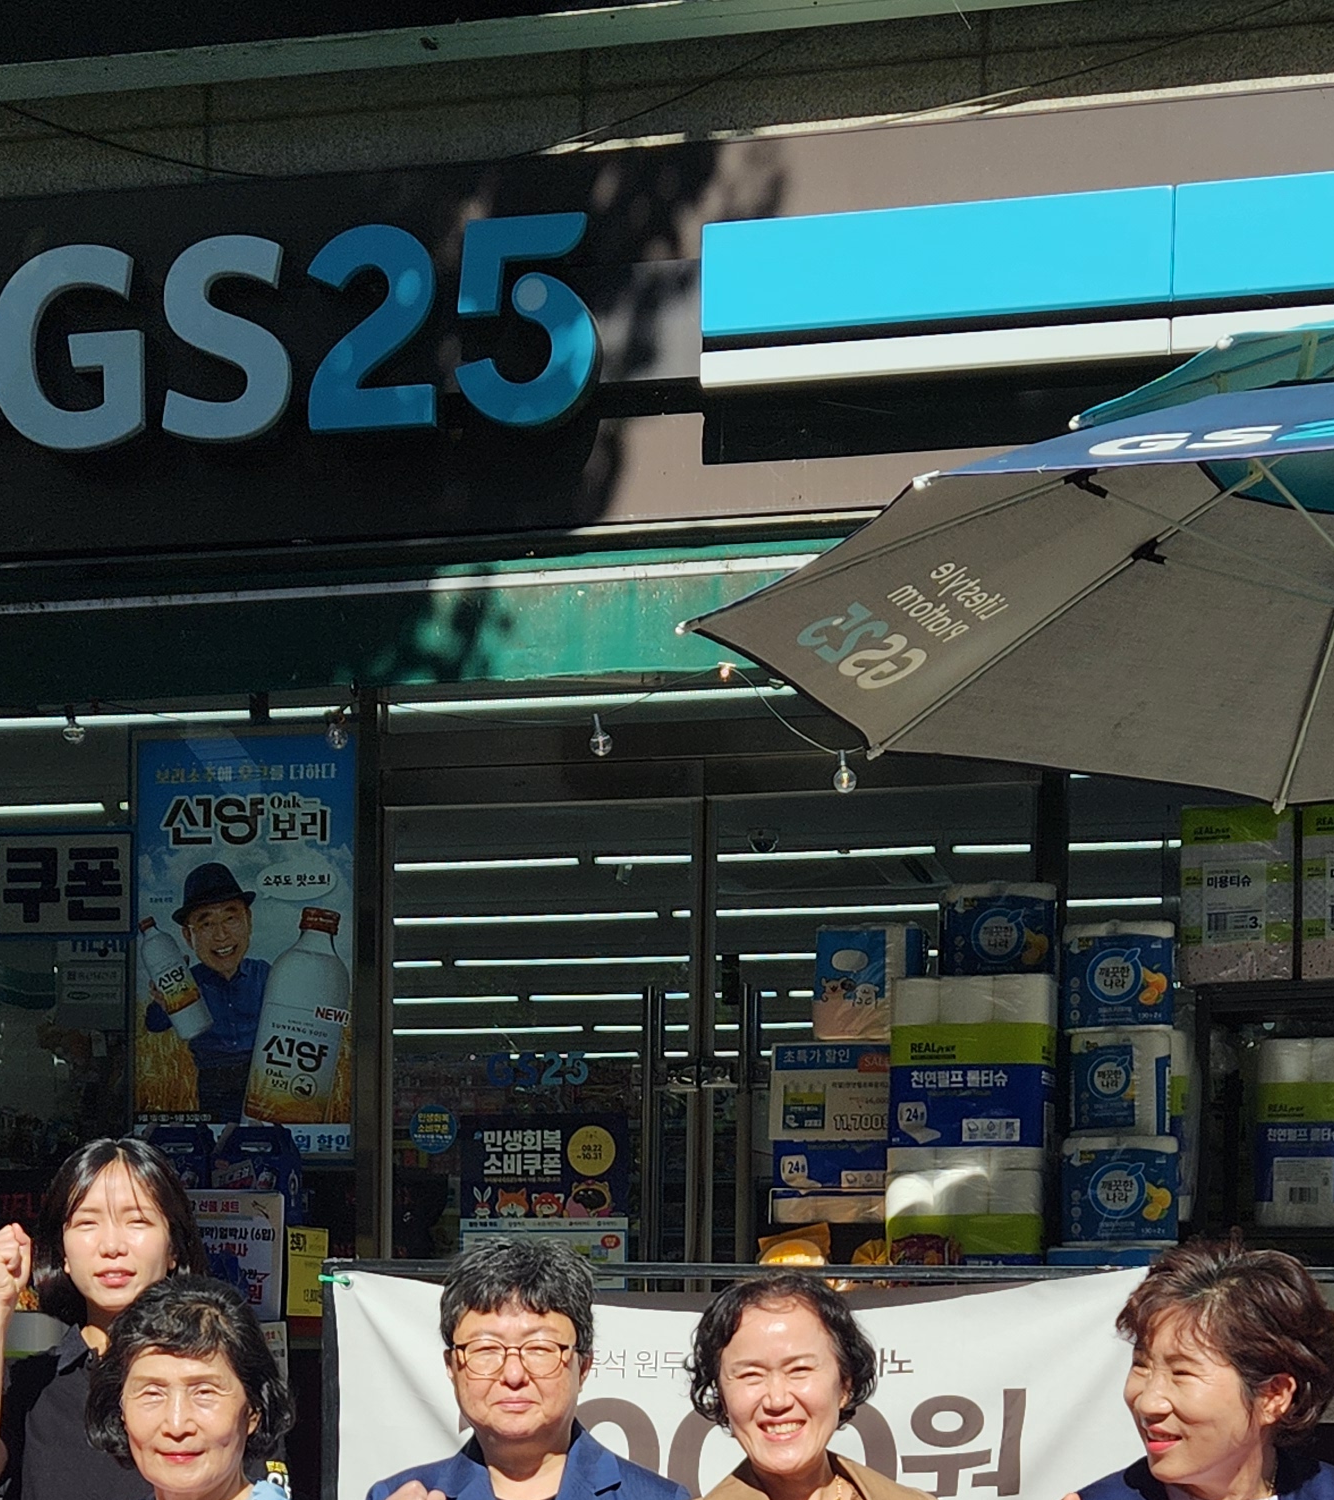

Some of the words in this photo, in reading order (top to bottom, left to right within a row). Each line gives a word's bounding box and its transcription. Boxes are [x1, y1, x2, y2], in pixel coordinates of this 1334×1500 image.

[289, 762, 337, 780] 더하다
[270, 795, 302, 809] Oak
[269, 809, 328, 842] 보리
[2, 846, 124, 923] 쿠폰
[1207, 875, 1252, 889] 미용티슈
[1098, 966, 1130, 978] 깨끗한
[1103, 978, 1126, 990] 나라
[315, 1006, 351, 1026] NEW!
[783, 1049, 821, 1064] 초특가
[825, 1048, 850, 1063] 할인
[487, 1051, 589, 1088] GS25
[1097, 1069, 1122, 1081] 깨끗한
[910, 1070, 964, 1088] 천연펄프
[1101, 1080, 1119, 1089] 나라
[483, 1129, 562, 1153] 민생회복
[1267, 1127, 1308, 1142] 천연펄프
[483, 1153, 562, 1176] 소비쿠폰
[1101, 1180, 1134, 1192] 깨끗한
[1106, 1192, 1130, 1203] 나라
